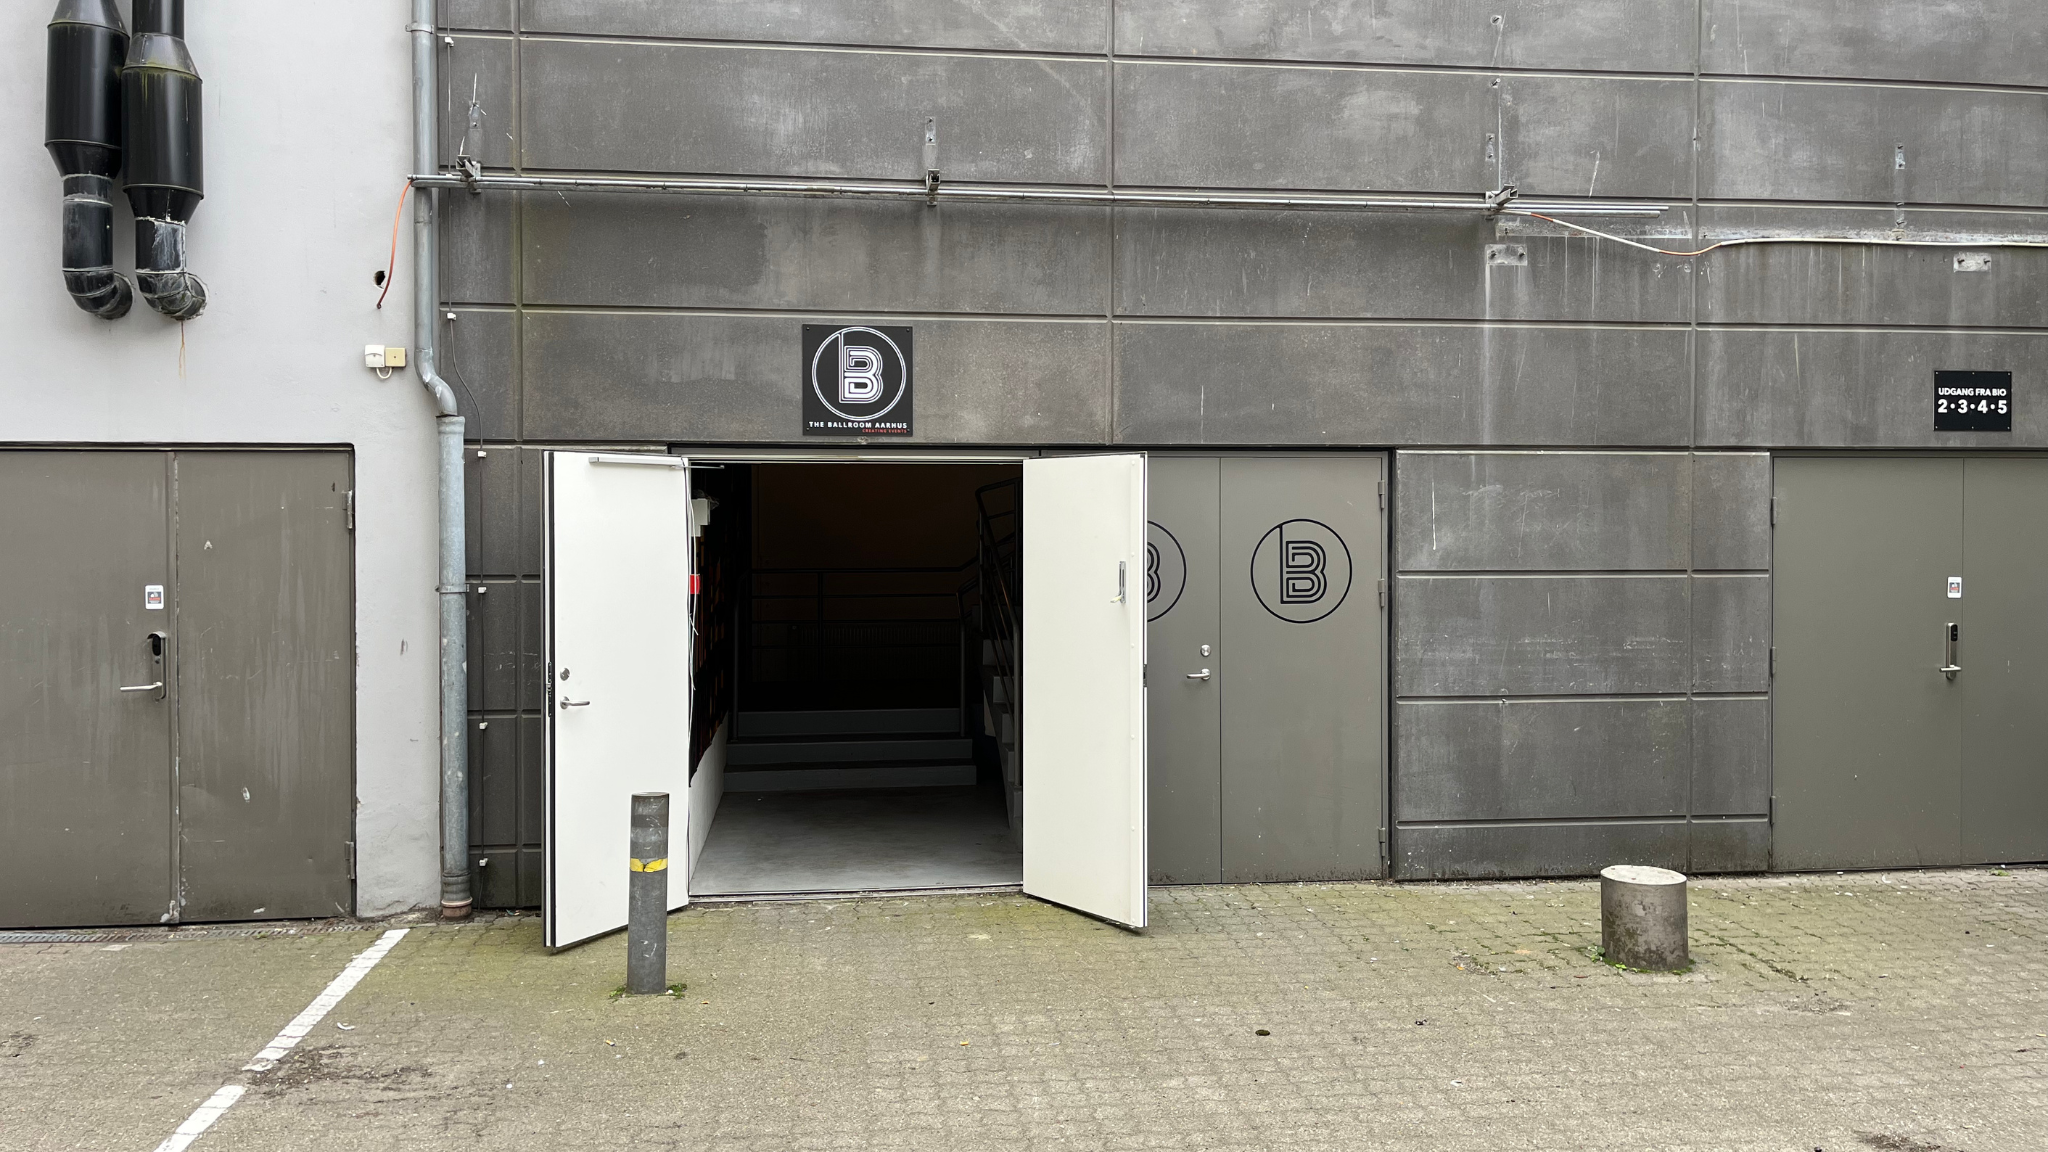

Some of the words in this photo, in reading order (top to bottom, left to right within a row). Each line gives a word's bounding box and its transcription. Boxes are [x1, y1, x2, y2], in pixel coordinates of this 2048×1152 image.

[839, 332, 884, 404] B
[1938, 387, 1974, 396] UDGANG
[1975, 388, 1991, 396] FRA
[1992, 388, 2007, 396] BIO
[1280, 525, 1328, 605] B
